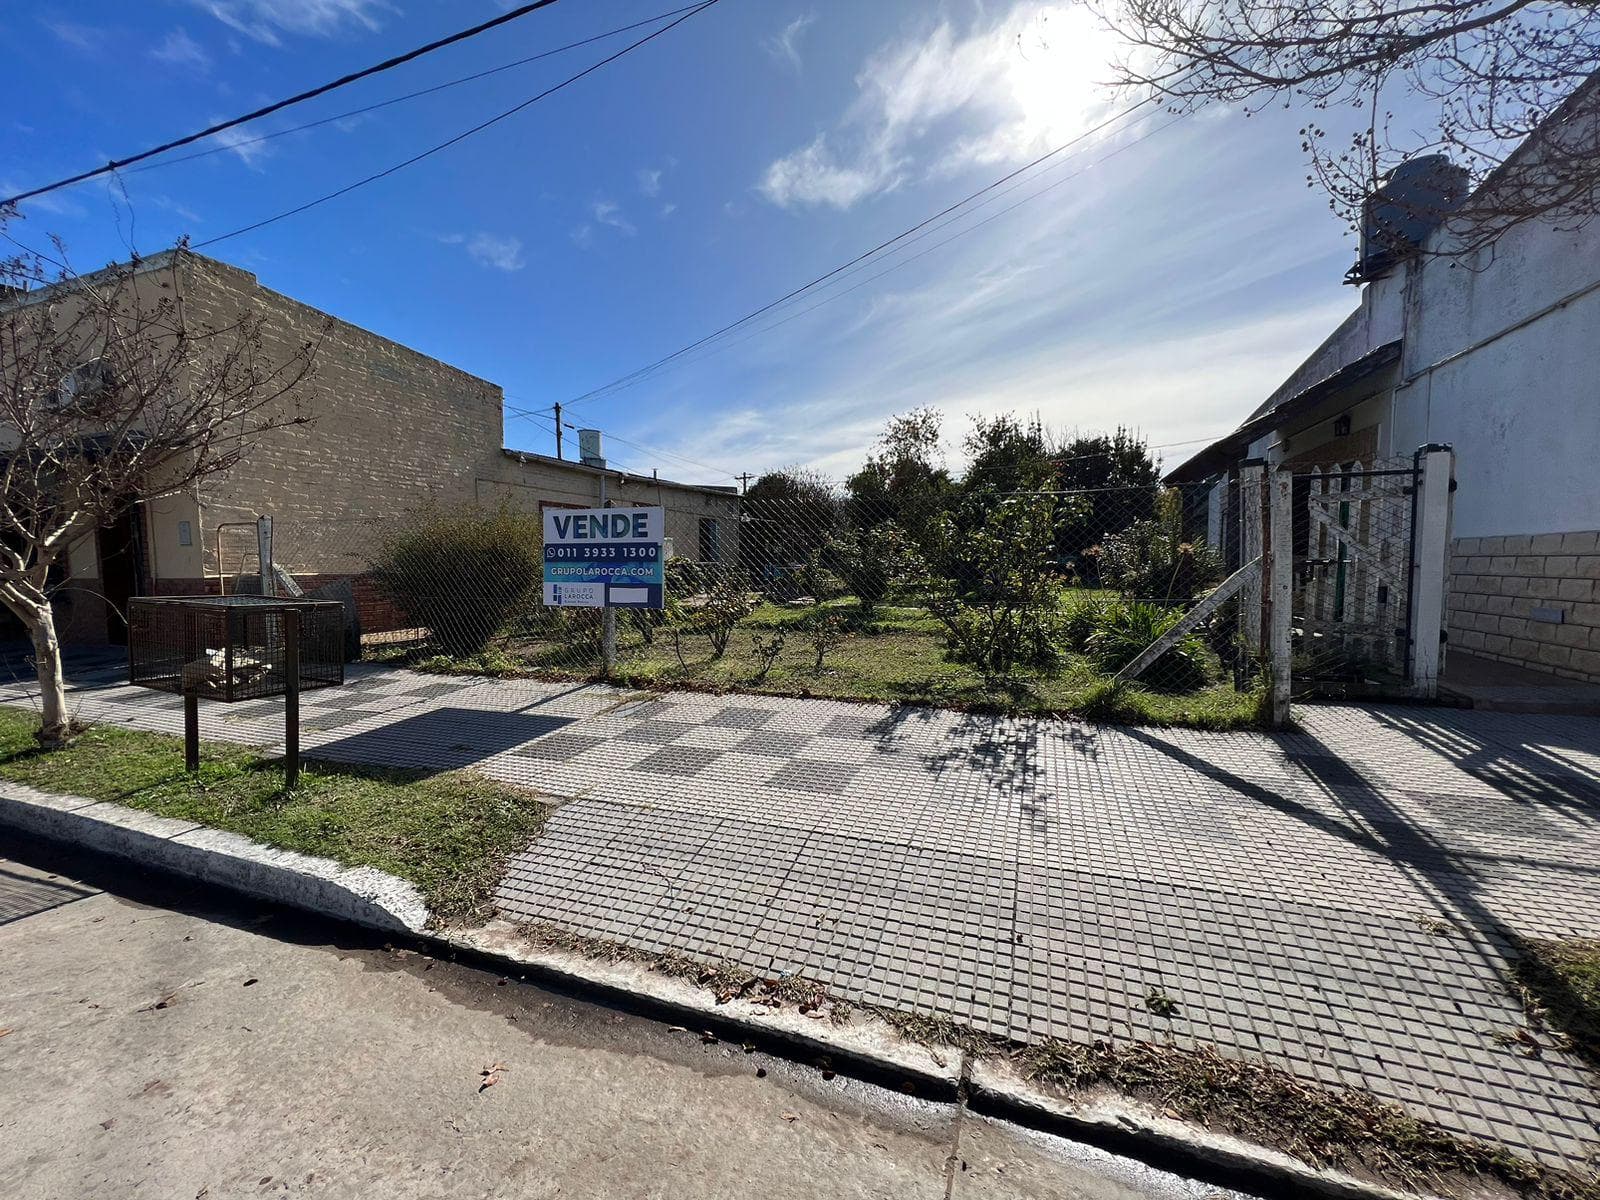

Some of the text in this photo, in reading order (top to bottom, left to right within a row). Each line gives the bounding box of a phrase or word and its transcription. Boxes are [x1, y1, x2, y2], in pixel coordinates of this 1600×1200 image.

[553, 513, 648, 539] VENDE
[558, 548, 656, 557] 011 3933 1300
[551, 567, 653, 576] GRUPOLAROCCA.COM
